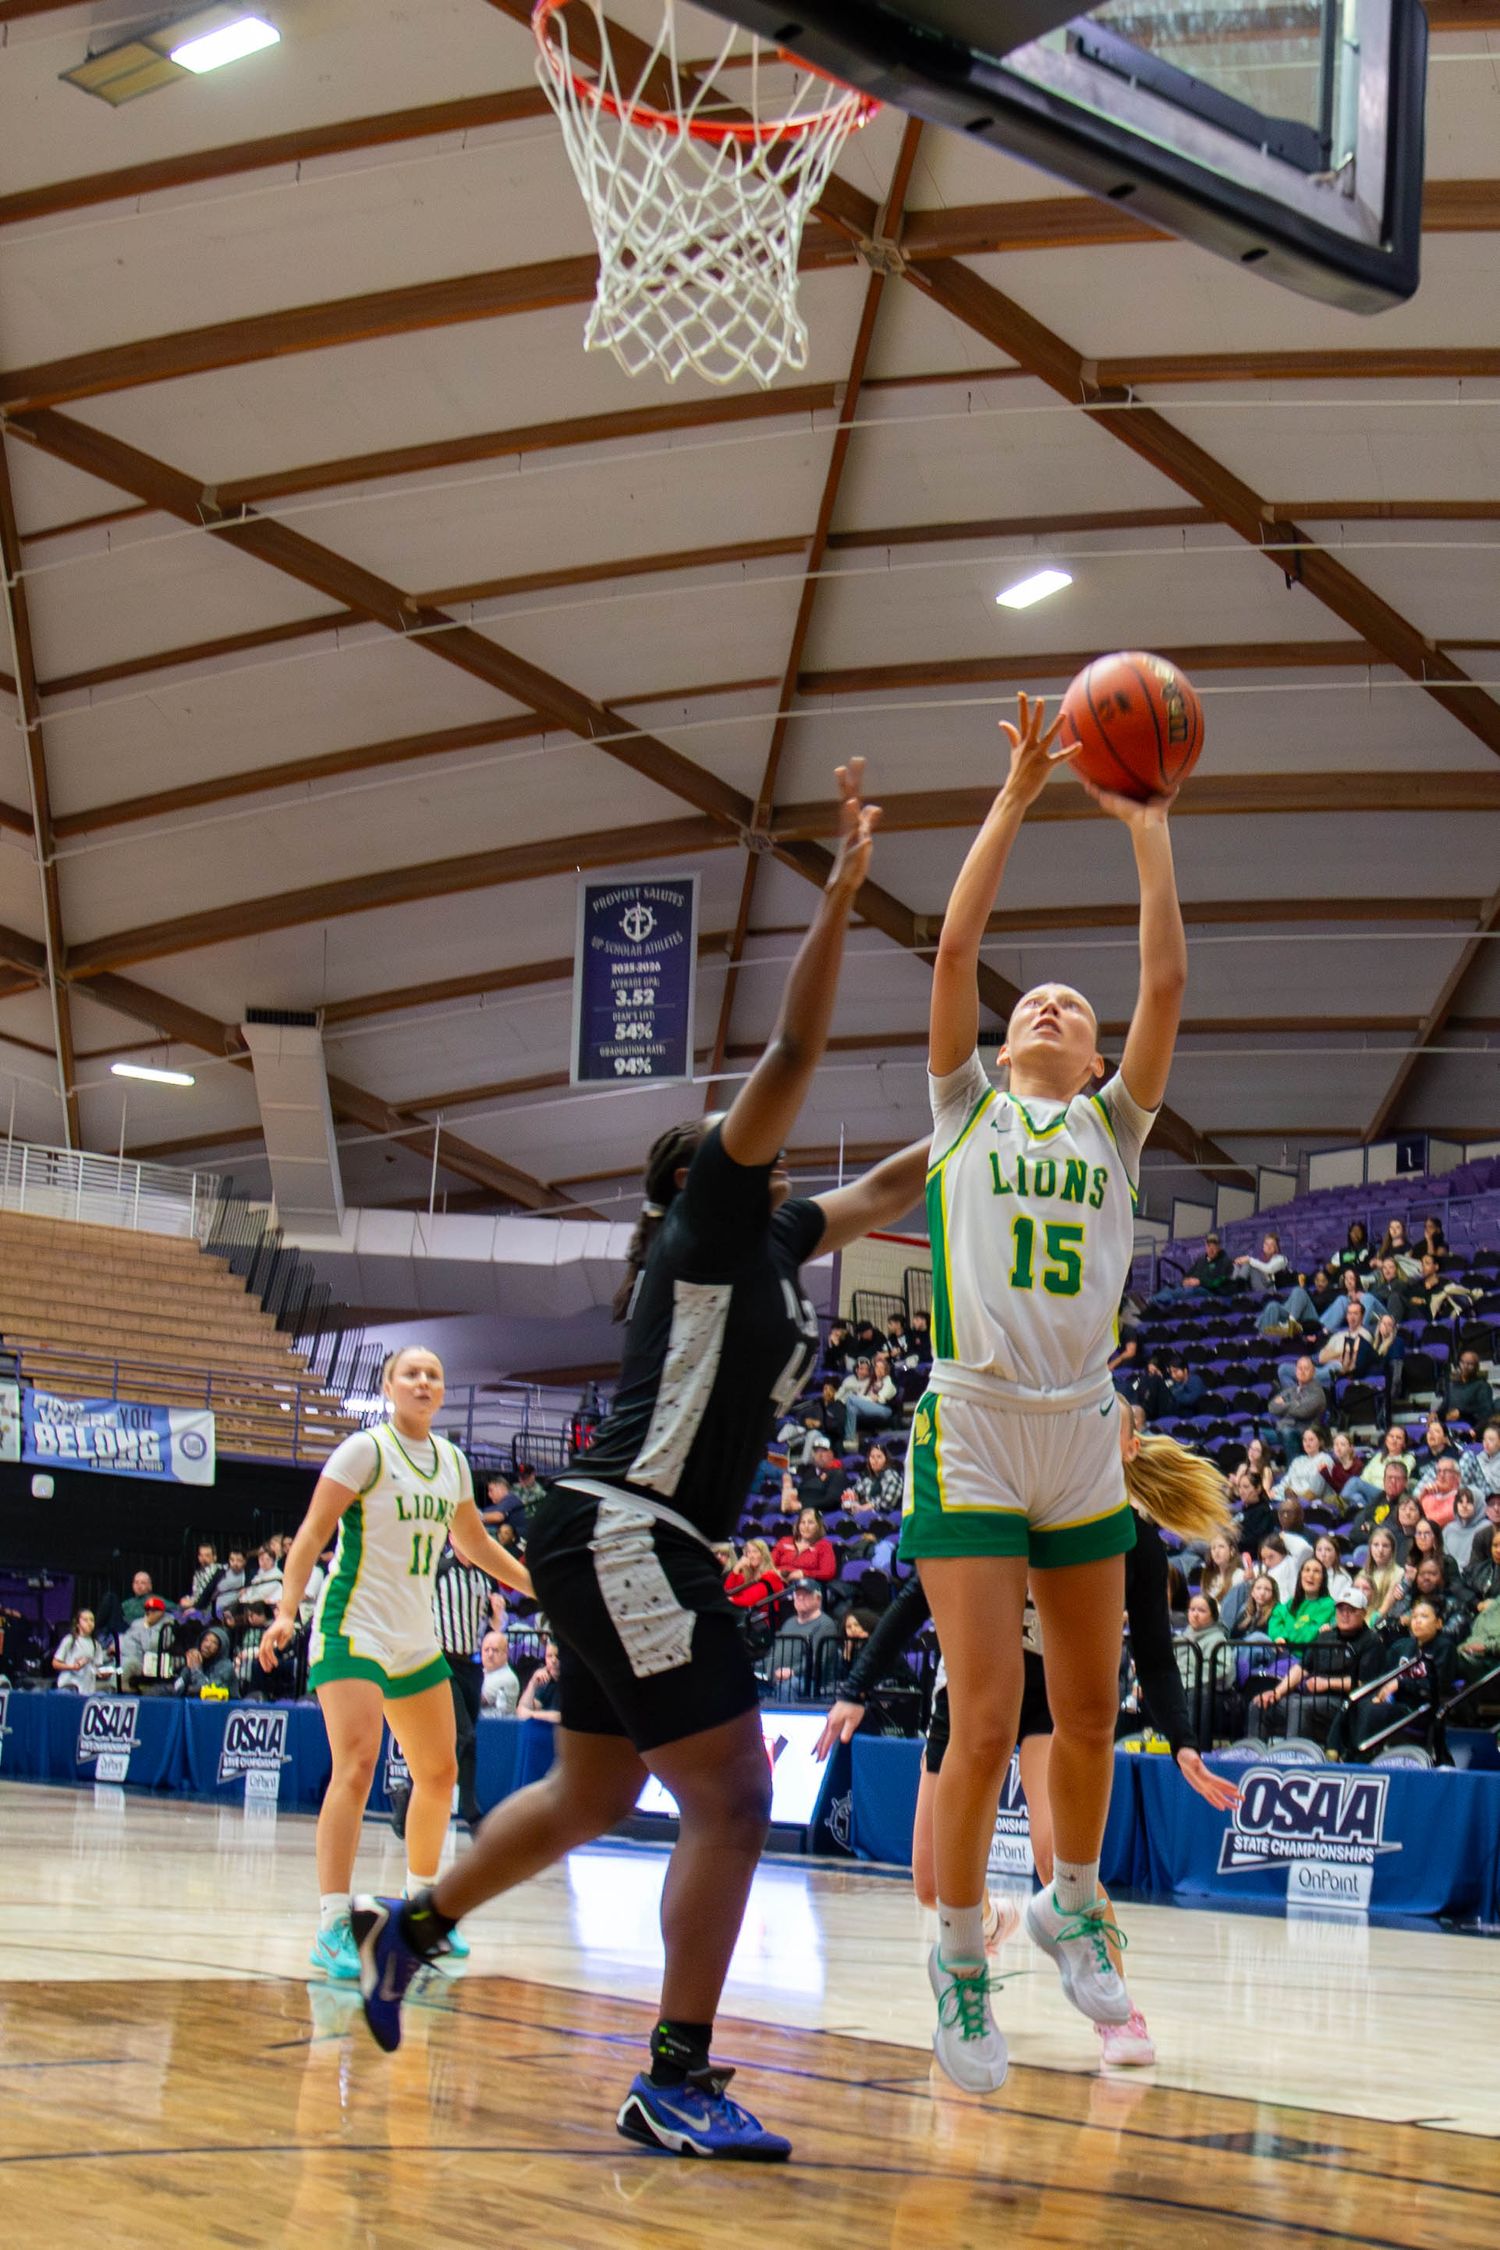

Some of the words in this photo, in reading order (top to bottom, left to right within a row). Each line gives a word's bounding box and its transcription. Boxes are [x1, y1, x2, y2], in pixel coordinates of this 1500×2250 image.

[615, 988, 655, 1007] 3.52
[615, 1022, 653, 1040] 54%
[614, 1057, 652, 1075] 94%
[989, 1151, 1109, 1211] LIONS
[1009, 1214, 1085, 1297] 15
[120, 1408, 152, 1429] YOU
[34, 1421, 160, 1461] BELONG
[409, 1532, 434, 1576] 11
[83, 1703, 136, 1739] OSAA
[226, 1716, 285, 1754] OSAA
[1238, 1776, 1381, 1843] OSAA
[991, 1840, 1027, 1861] nPoint
[1233, 1835, 1270, 1855] STATE
[1271, 1838, 1375, 1864] CHAMPIONSHIPS
[1298, 1866, 1359, 1894] OnPoint
